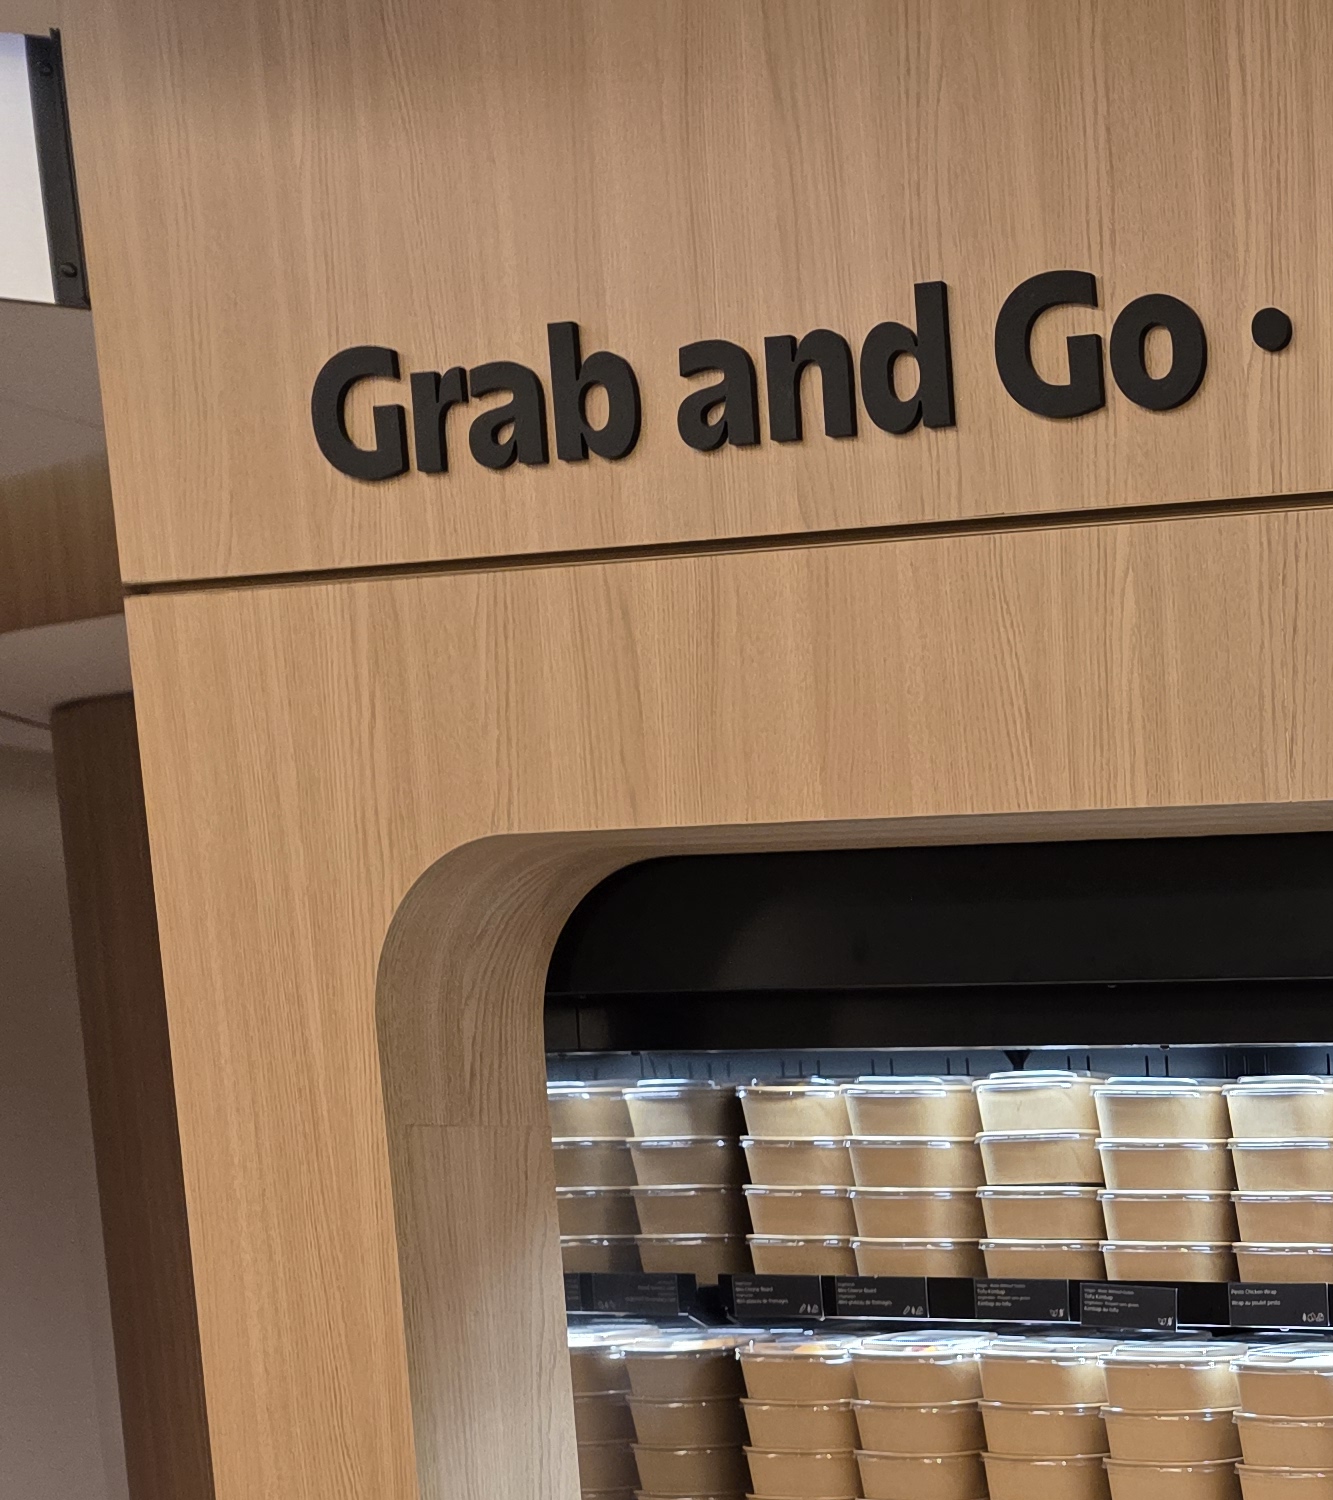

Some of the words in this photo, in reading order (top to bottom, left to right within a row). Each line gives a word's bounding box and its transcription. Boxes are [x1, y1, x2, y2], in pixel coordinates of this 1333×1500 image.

[312, 322, 642, 483] Grab
[678, 281, 956, 452] and
[995, 270, 1207, 420] Go
